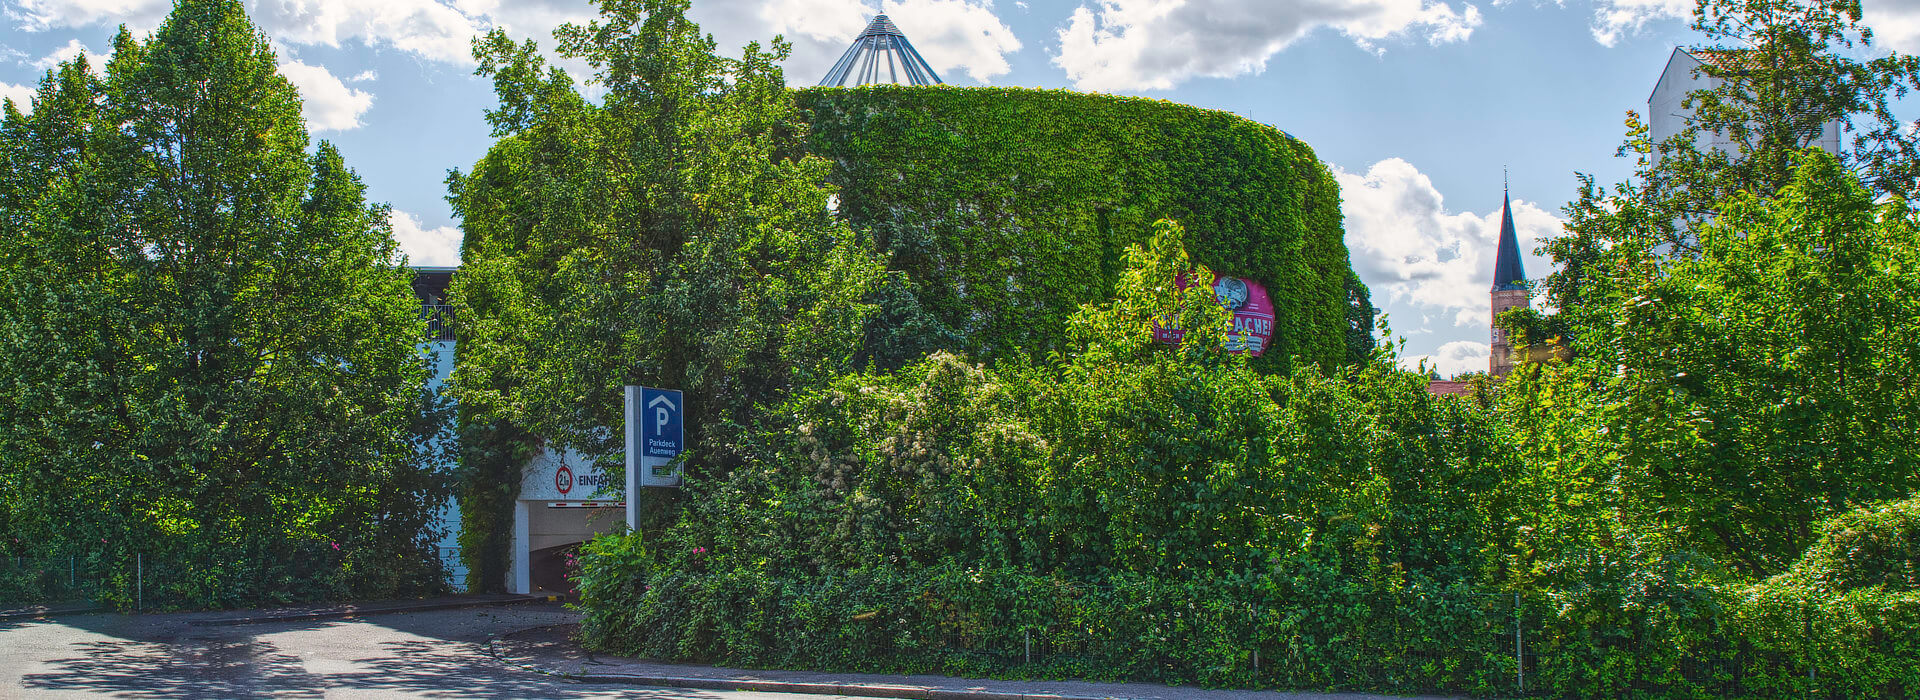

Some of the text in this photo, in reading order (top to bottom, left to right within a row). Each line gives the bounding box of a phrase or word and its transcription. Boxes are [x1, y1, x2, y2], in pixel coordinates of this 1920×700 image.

[656, 407, 669, 436] P
[649, 438, 676, 448] Parkdeck
[649, 447, 676, 457] Auenweg
[578, 474, 612, 486] EINFAH
